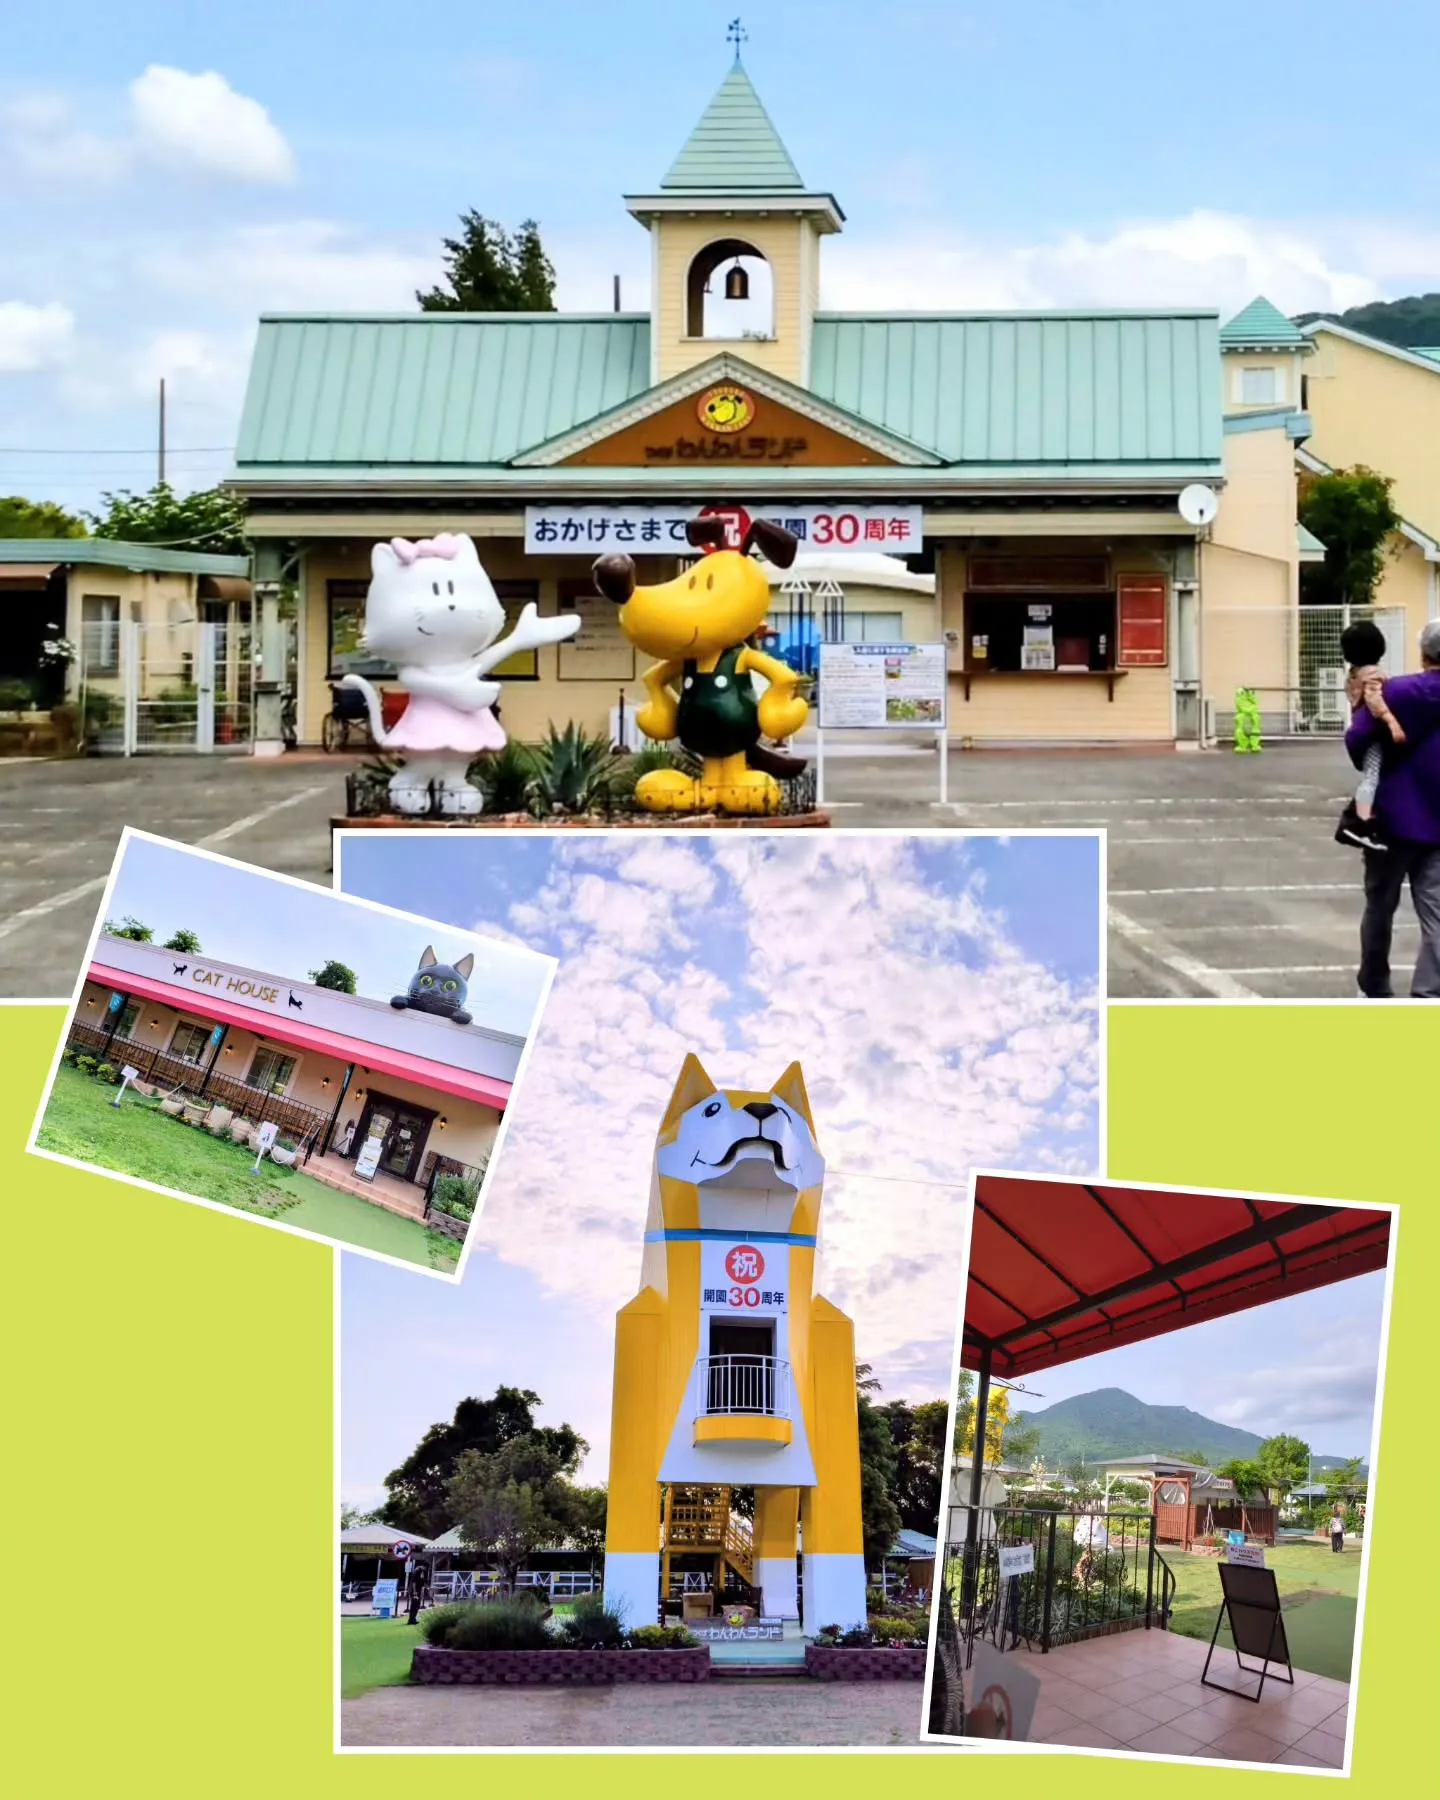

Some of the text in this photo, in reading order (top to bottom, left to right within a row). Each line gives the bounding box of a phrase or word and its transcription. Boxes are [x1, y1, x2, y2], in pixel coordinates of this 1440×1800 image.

[534, 517, 687, 542] おかげさまで
[765, 513, 911, 545] 園30周年
[192, 968, 280, 1003] CAT HOUSE
[731, 1251, 758, 1278] 祝
[703, 1286, 785, 1308] 開園30周年
